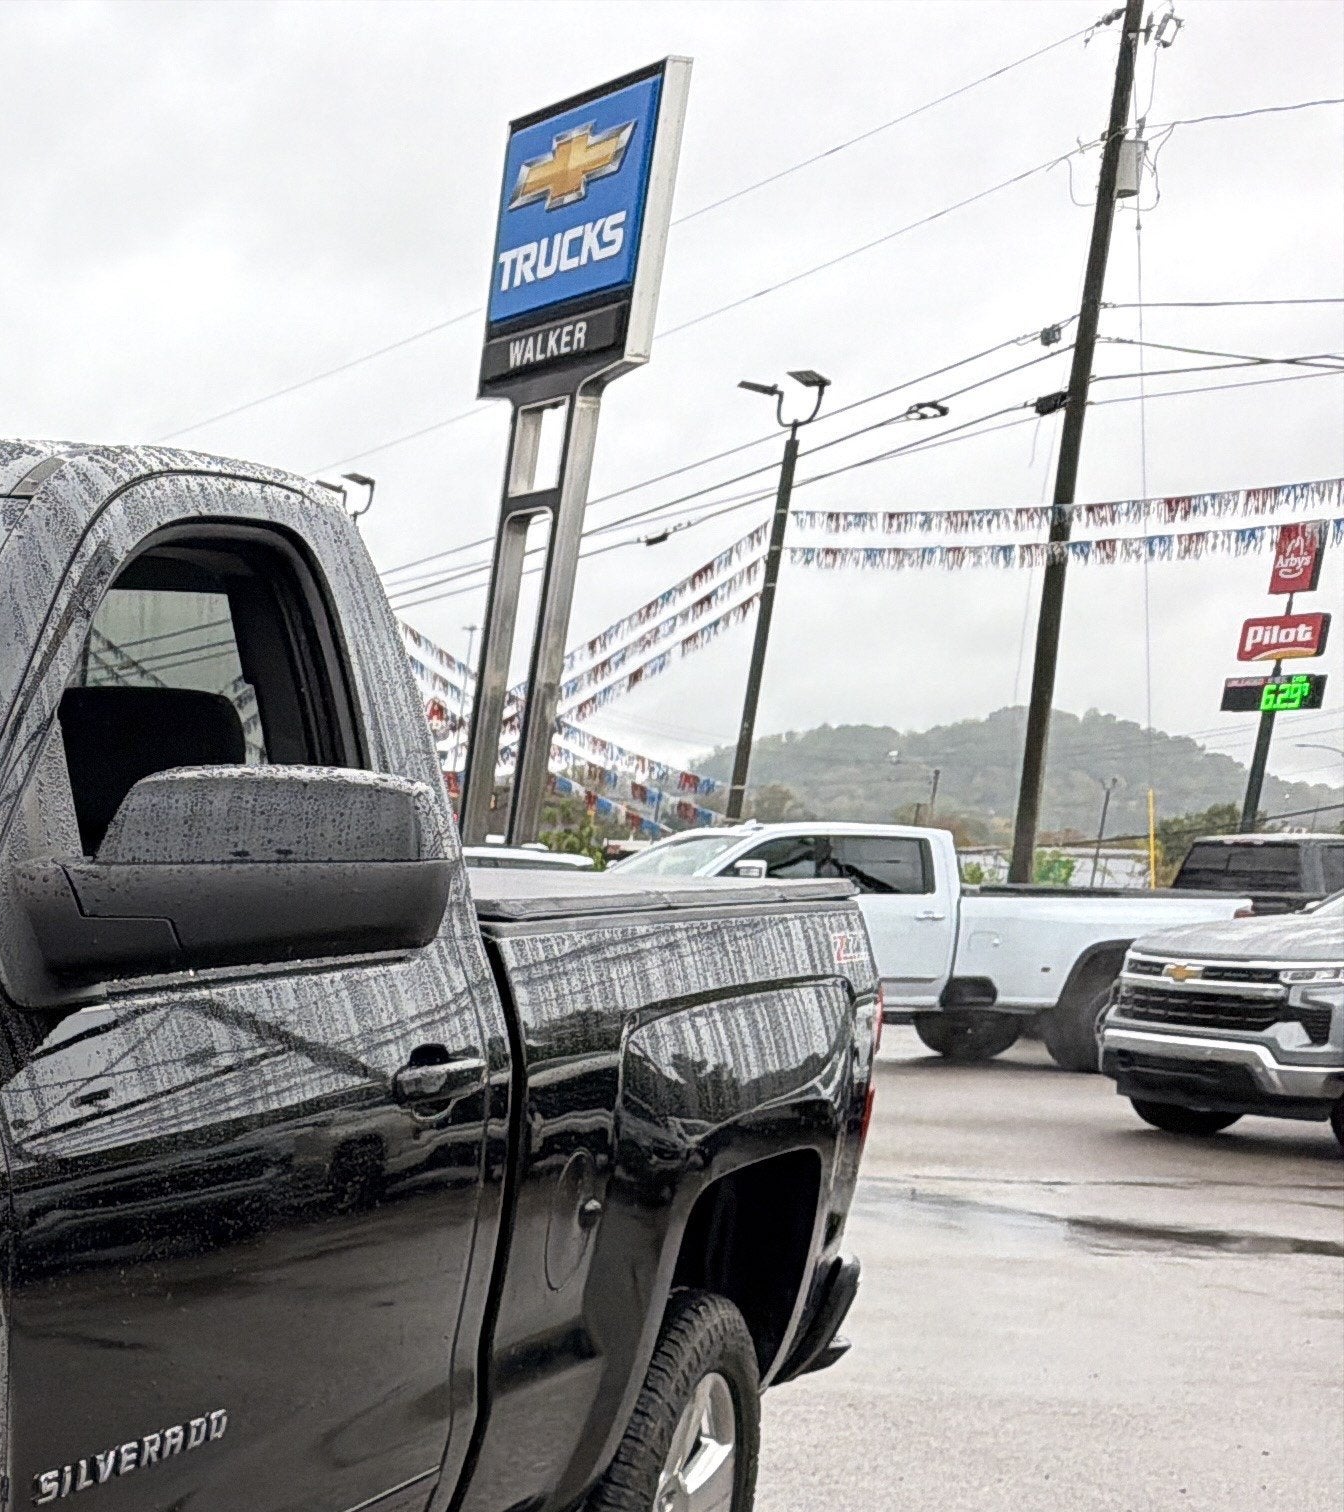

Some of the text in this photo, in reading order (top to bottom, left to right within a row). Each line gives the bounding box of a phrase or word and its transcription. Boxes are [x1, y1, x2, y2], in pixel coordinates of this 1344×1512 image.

[498, 211, 628, 292] TRUCKS
[509, 321, 587, 368] WALKER
[1275, 551, 1312, 570] Arby's
[1245, 623, 1313, 653] Pilot
[33, 1408, 228, 1506] SILVERADO
